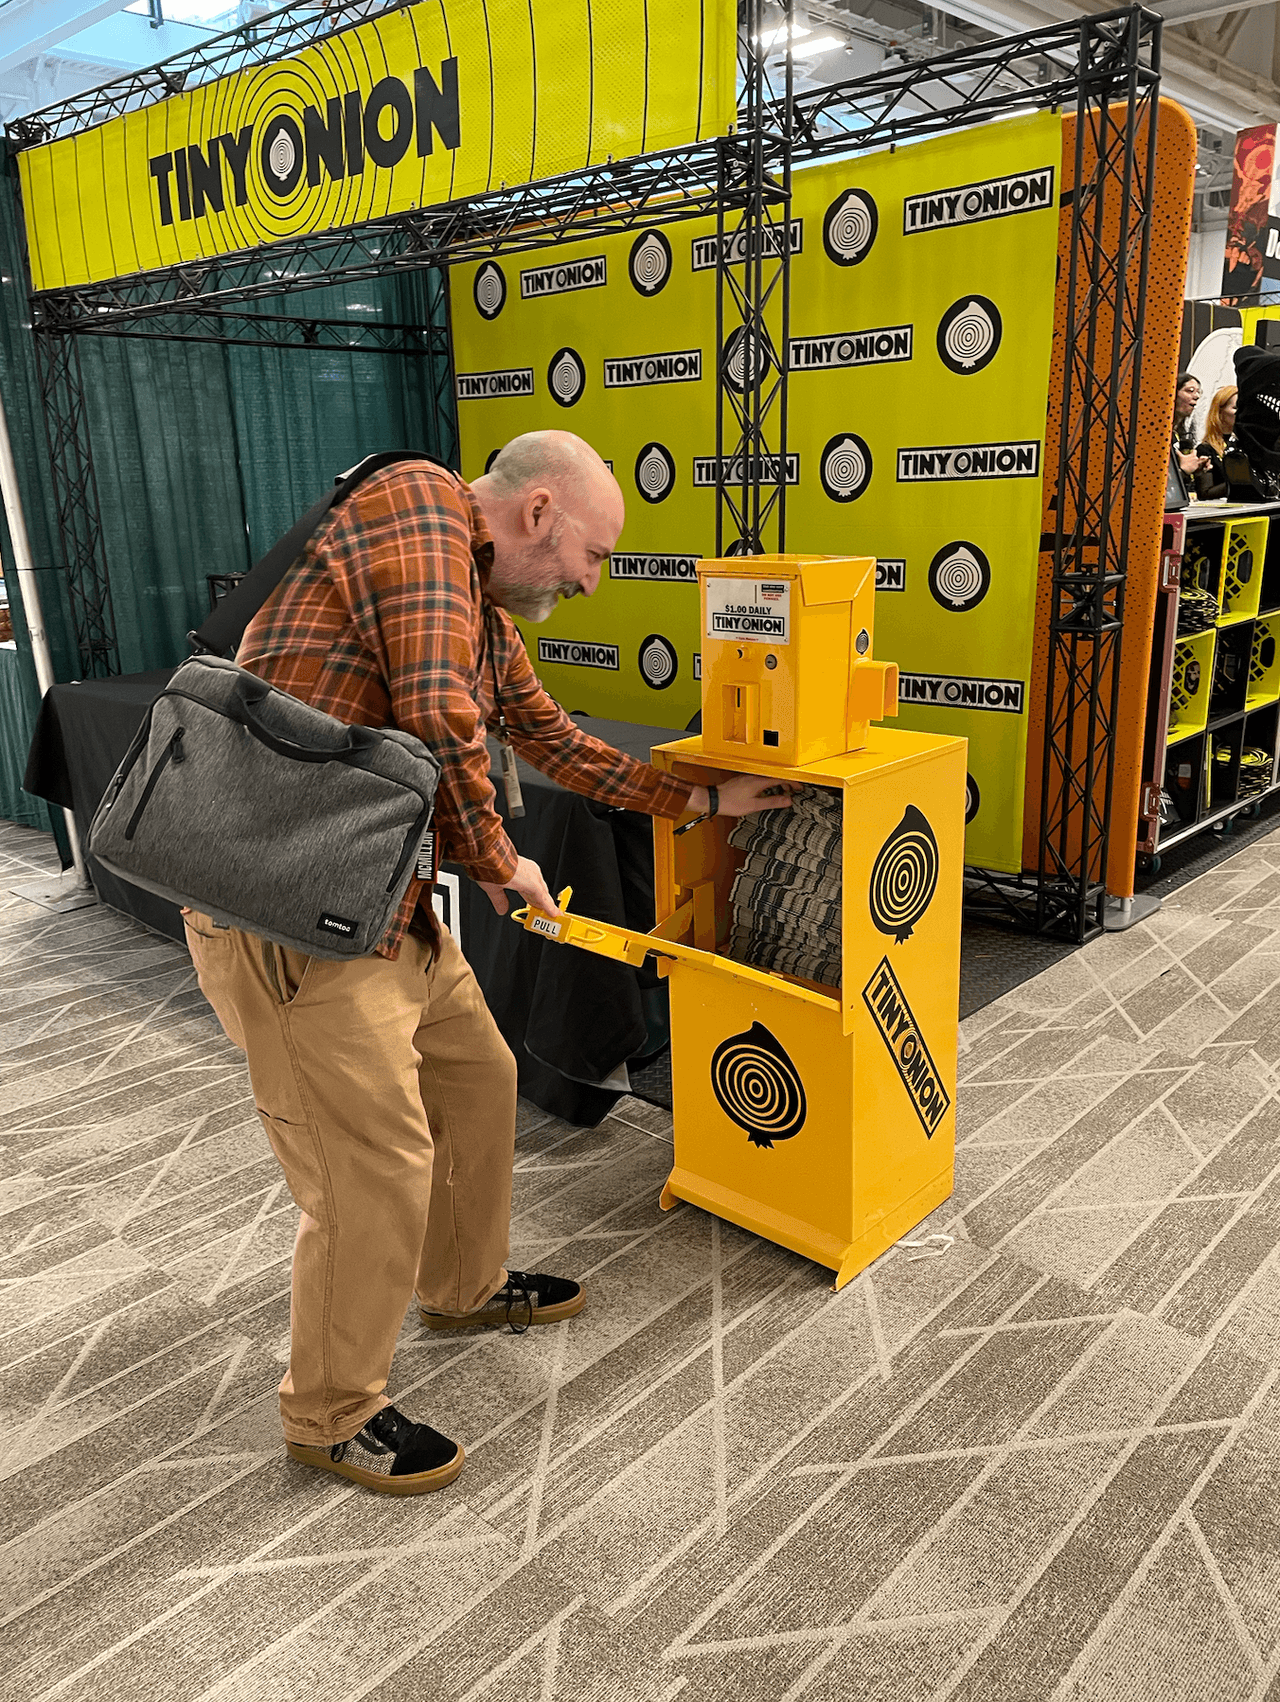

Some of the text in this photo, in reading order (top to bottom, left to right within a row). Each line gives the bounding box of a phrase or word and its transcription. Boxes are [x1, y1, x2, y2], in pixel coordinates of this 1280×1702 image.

[725, 604, 772, 615] $1.00 DAILY
[533, 919, 558, 935] PULL
